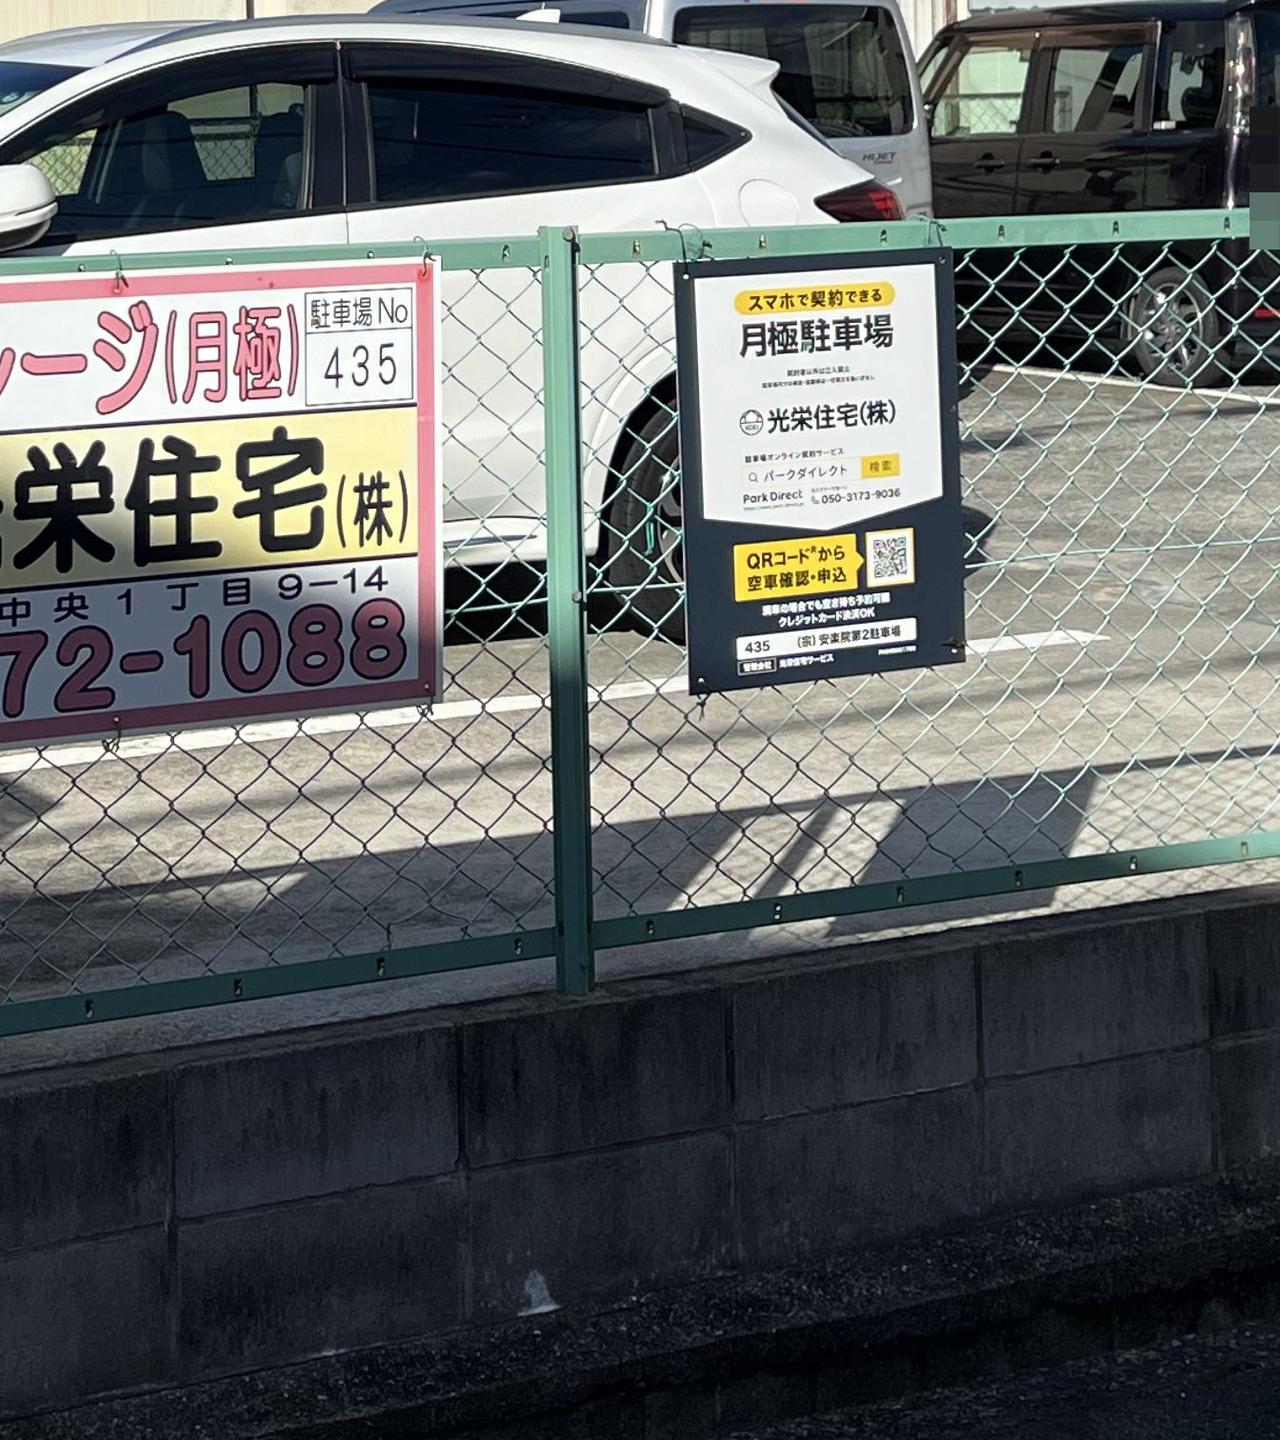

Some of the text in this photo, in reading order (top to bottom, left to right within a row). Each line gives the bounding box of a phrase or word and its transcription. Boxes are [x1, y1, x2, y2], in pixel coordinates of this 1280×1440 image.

[748, 288, 883, 312] スマホで契約できる
[739, 314, 894, 358] 月極駐車場
[323, 341, 398, 390] 435
[767, 399, 896, 434] 光栄住宅(株)
[764, 464, 847, 482] パークダイレクト
[742, 492, 769, 504] Park
[770, 489, 803, 501] Direct
[747, 566, 847, 592] 空車確認・申込
[745, 641, 771, 653] 435
